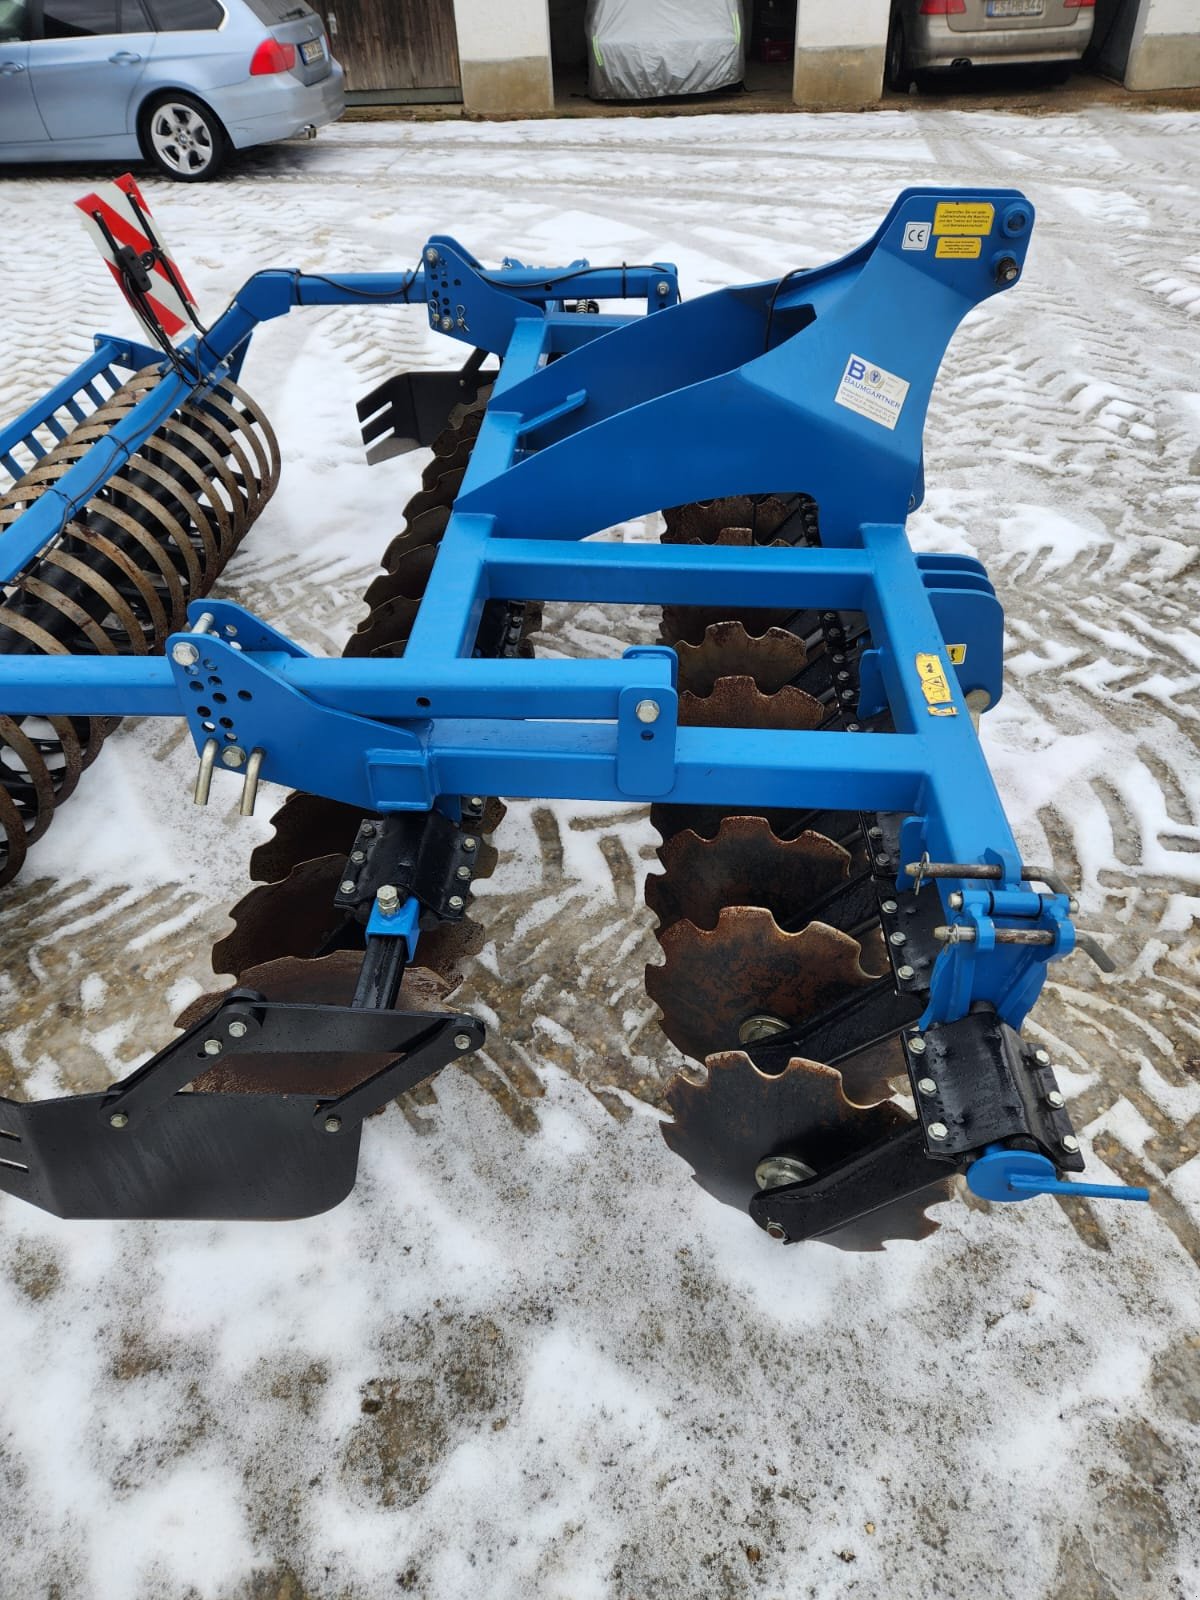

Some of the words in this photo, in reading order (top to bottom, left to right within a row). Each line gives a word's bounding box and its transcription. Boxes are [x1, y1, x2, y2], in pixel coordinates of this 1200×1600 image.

[908, 229, 925, 242] CE
[847, 358, 866, 380] B
[843, 375, 901, 410] BAUMGARTNER
